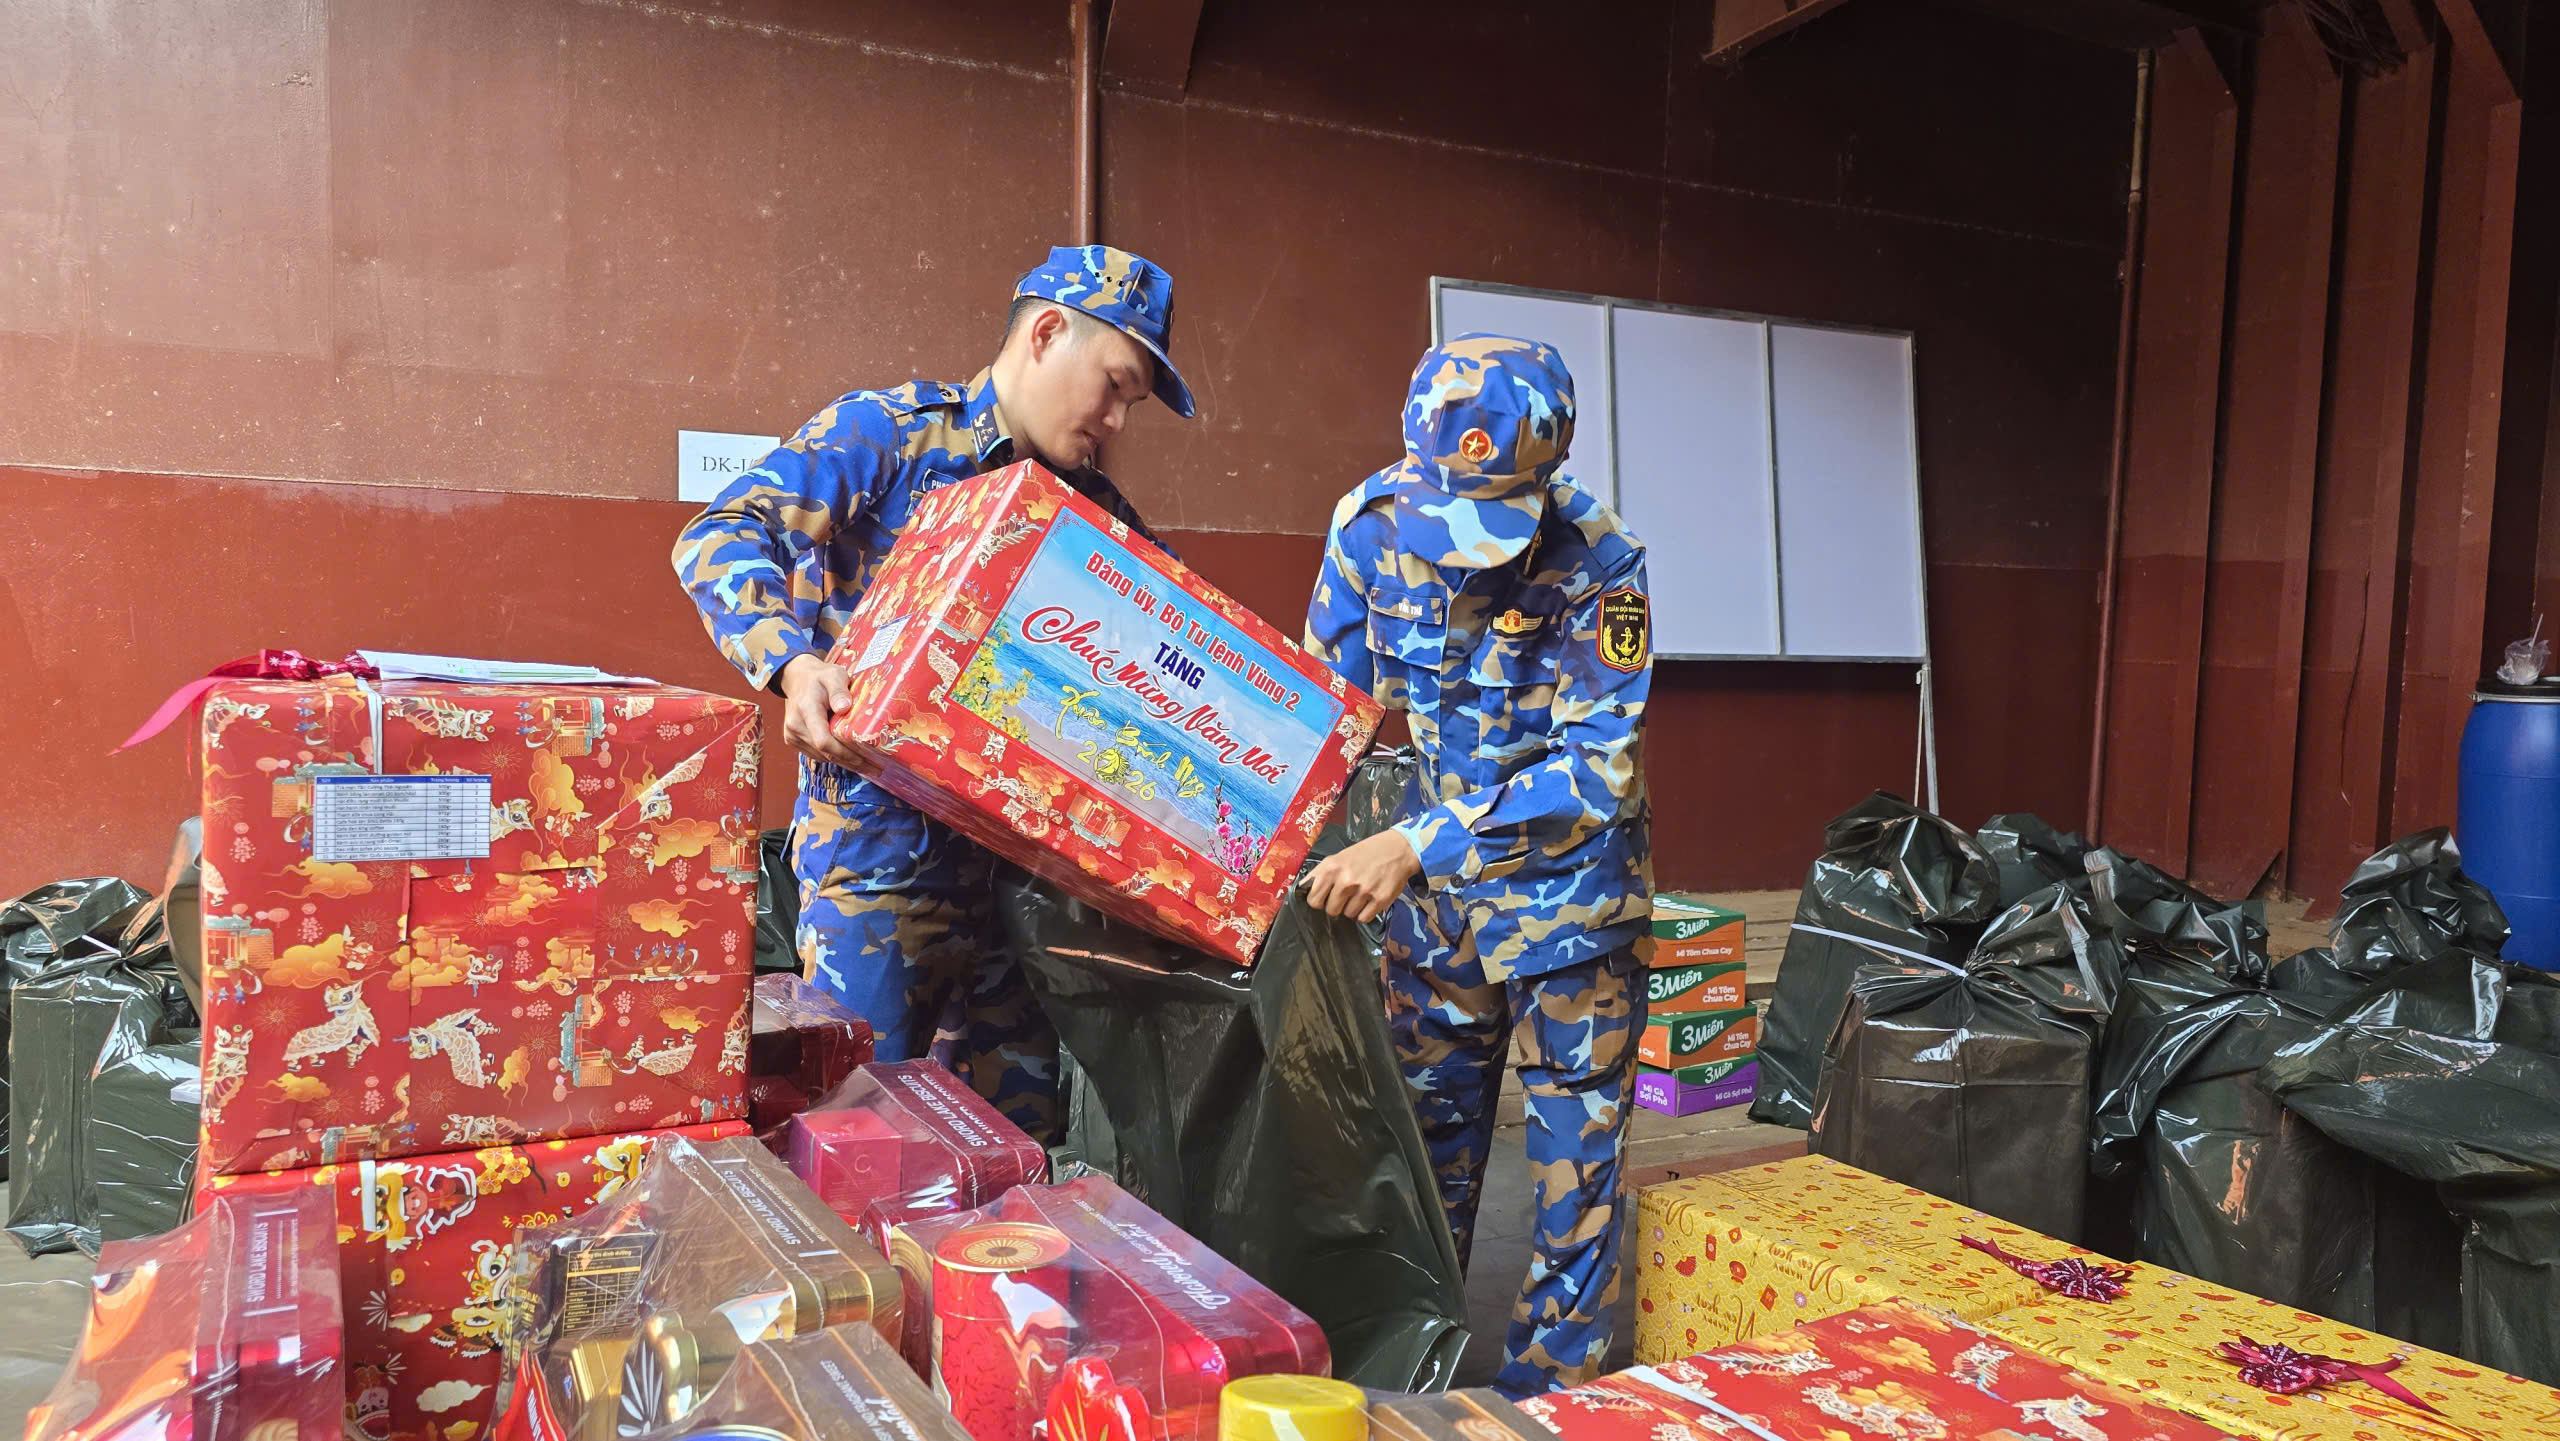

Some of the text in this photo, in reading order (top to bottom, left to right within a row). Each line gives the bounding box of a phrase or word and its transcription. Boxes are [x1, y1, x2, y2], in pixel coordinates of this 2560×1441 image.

[931, 479, 951, 490] PHA
[1086, 551, 1301, 712] Đảng ủy, Bộ Tư lệnh Vùng 2
[1153, 641, 1206, 690] TẶNG
[1021, 606, 1290, 785] Chúc Mừng Năm Mới
[897, 1074, 988, 1147] SWORD LAKE BISCUITS
[747, 1198, 775, 1217] LAKE
[766, 1217, 801, 1245] SWORD
